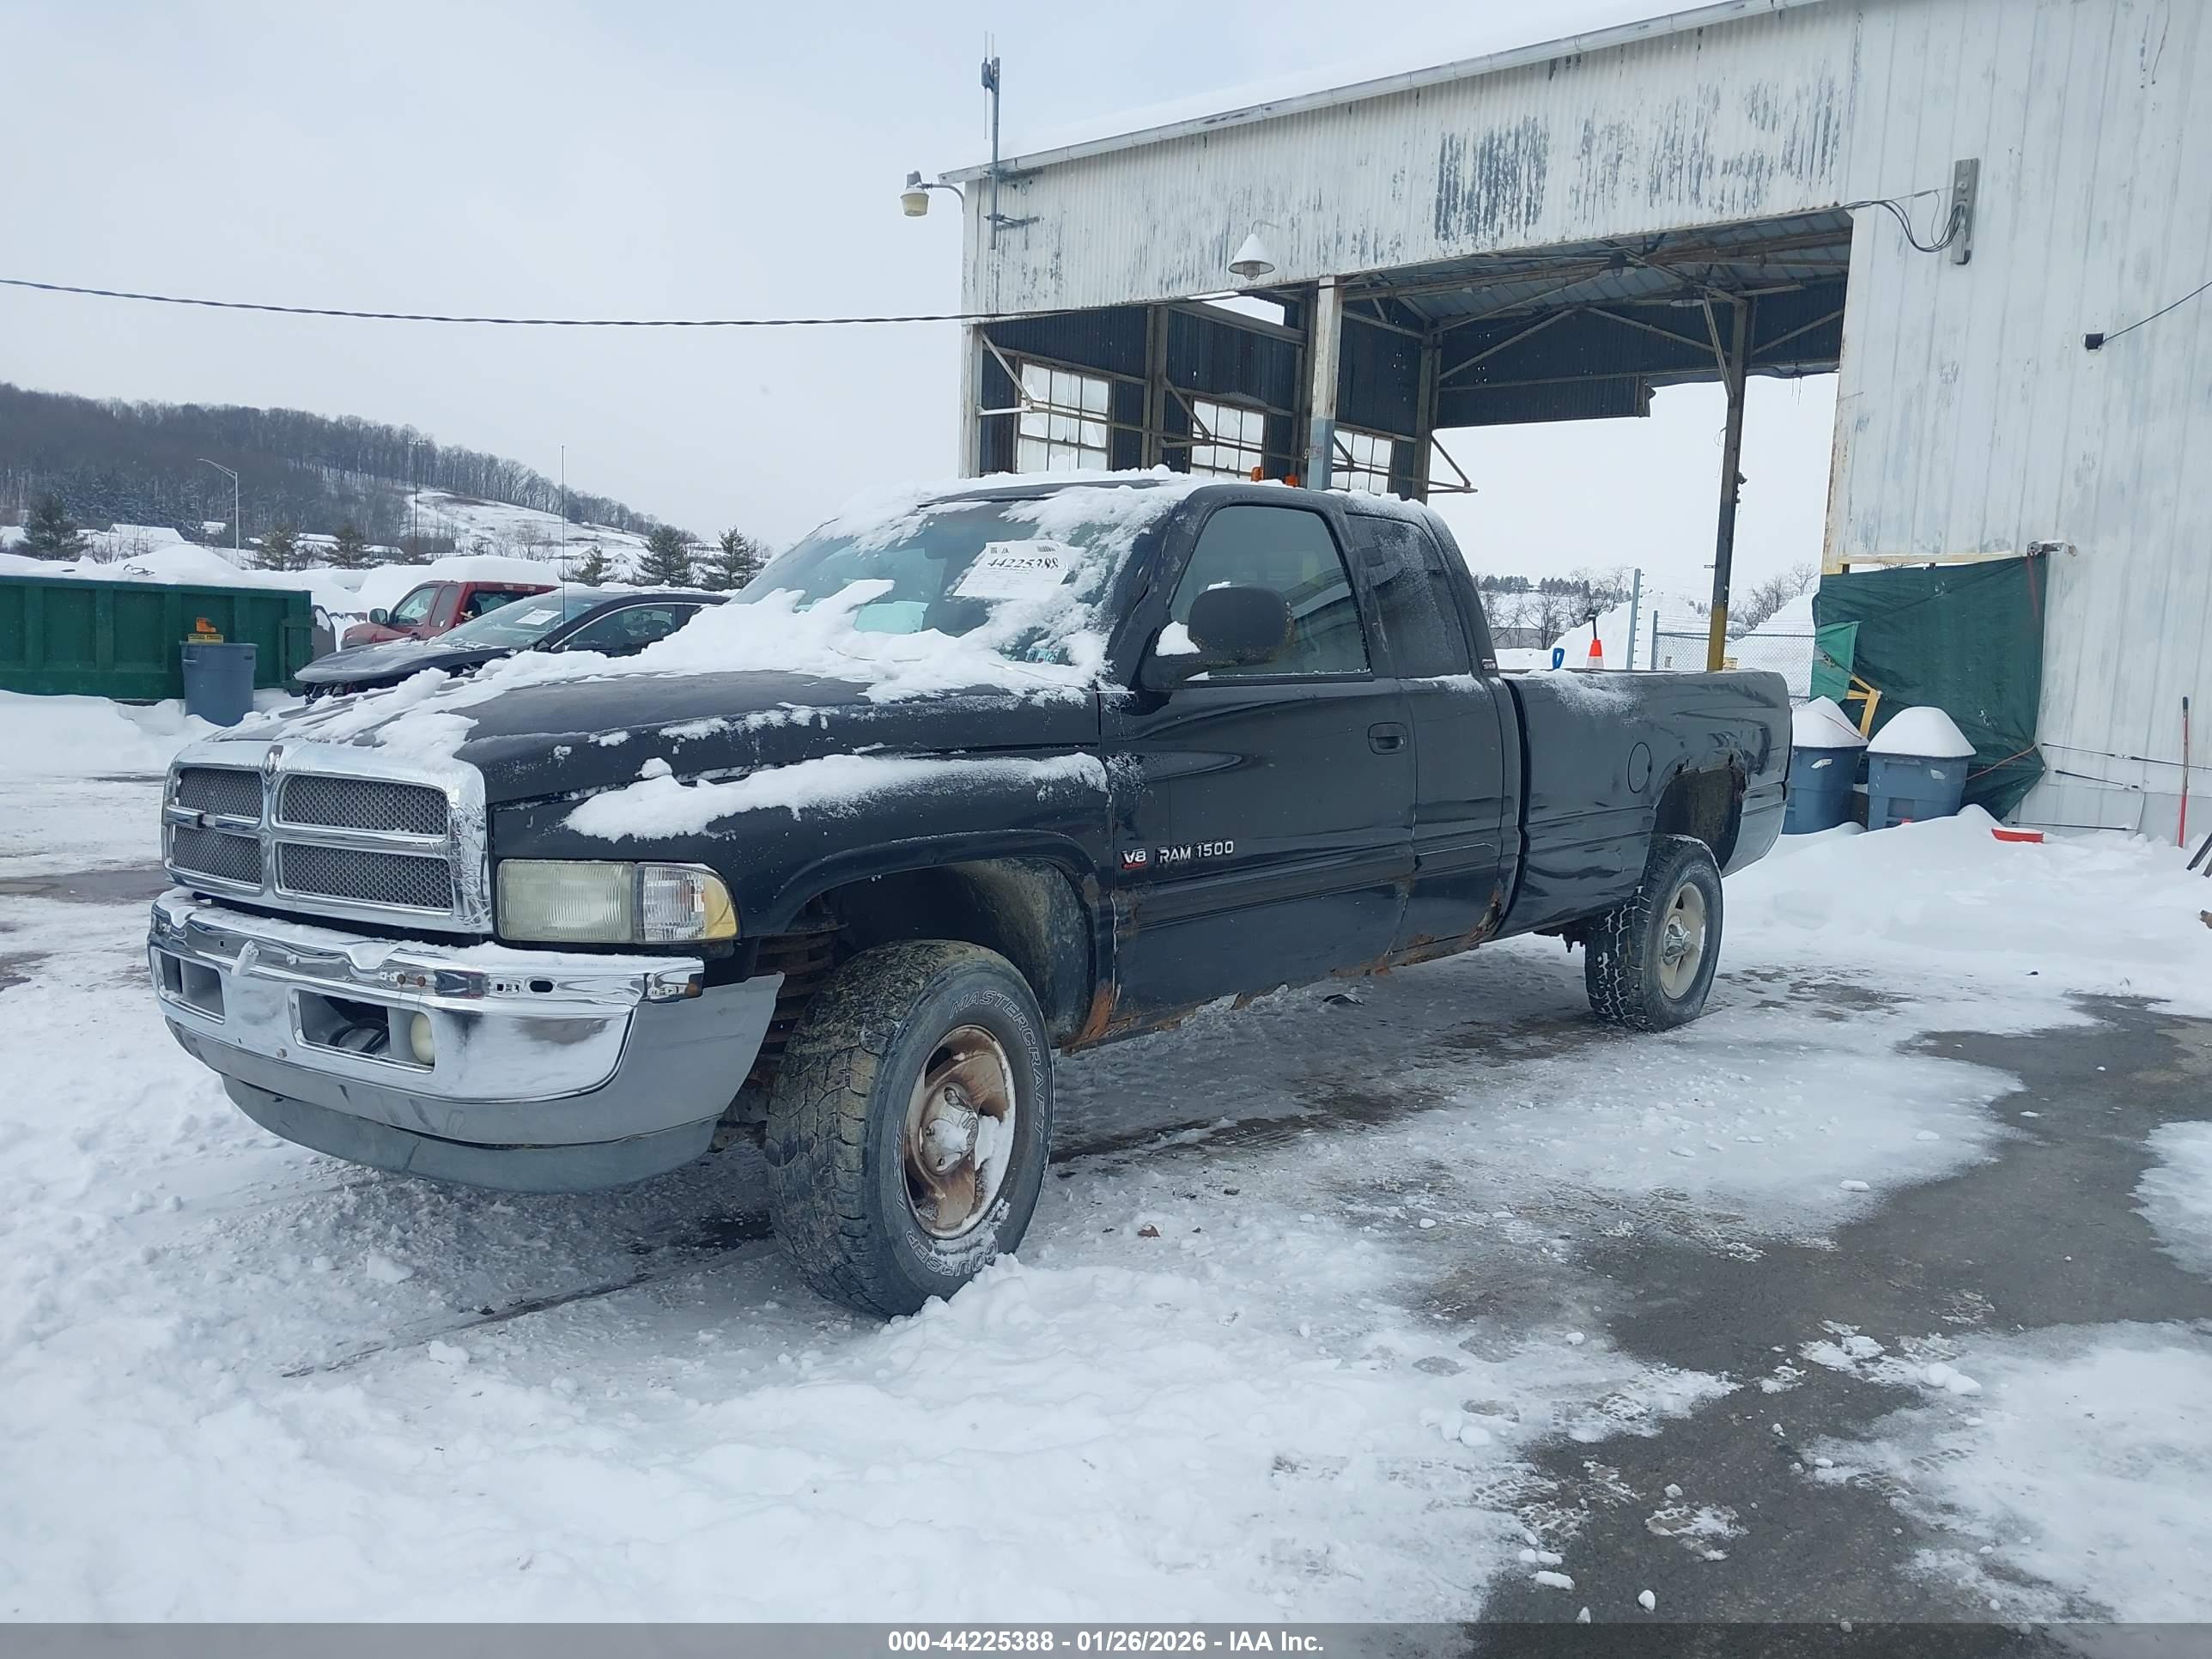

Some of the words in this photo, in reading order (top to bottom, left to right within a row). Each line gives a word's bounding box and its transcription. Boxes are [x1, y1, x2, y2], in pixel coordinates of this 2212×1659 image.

[1123, 850, 1146, 864] V8
[1159, 847, 1191, 864] RAM
[1197, 841, 1234, 858] 1500
[949, 990, 1045, 1144] MASTERCRAFT
[906, 1229, 999, 1277] COURSER
